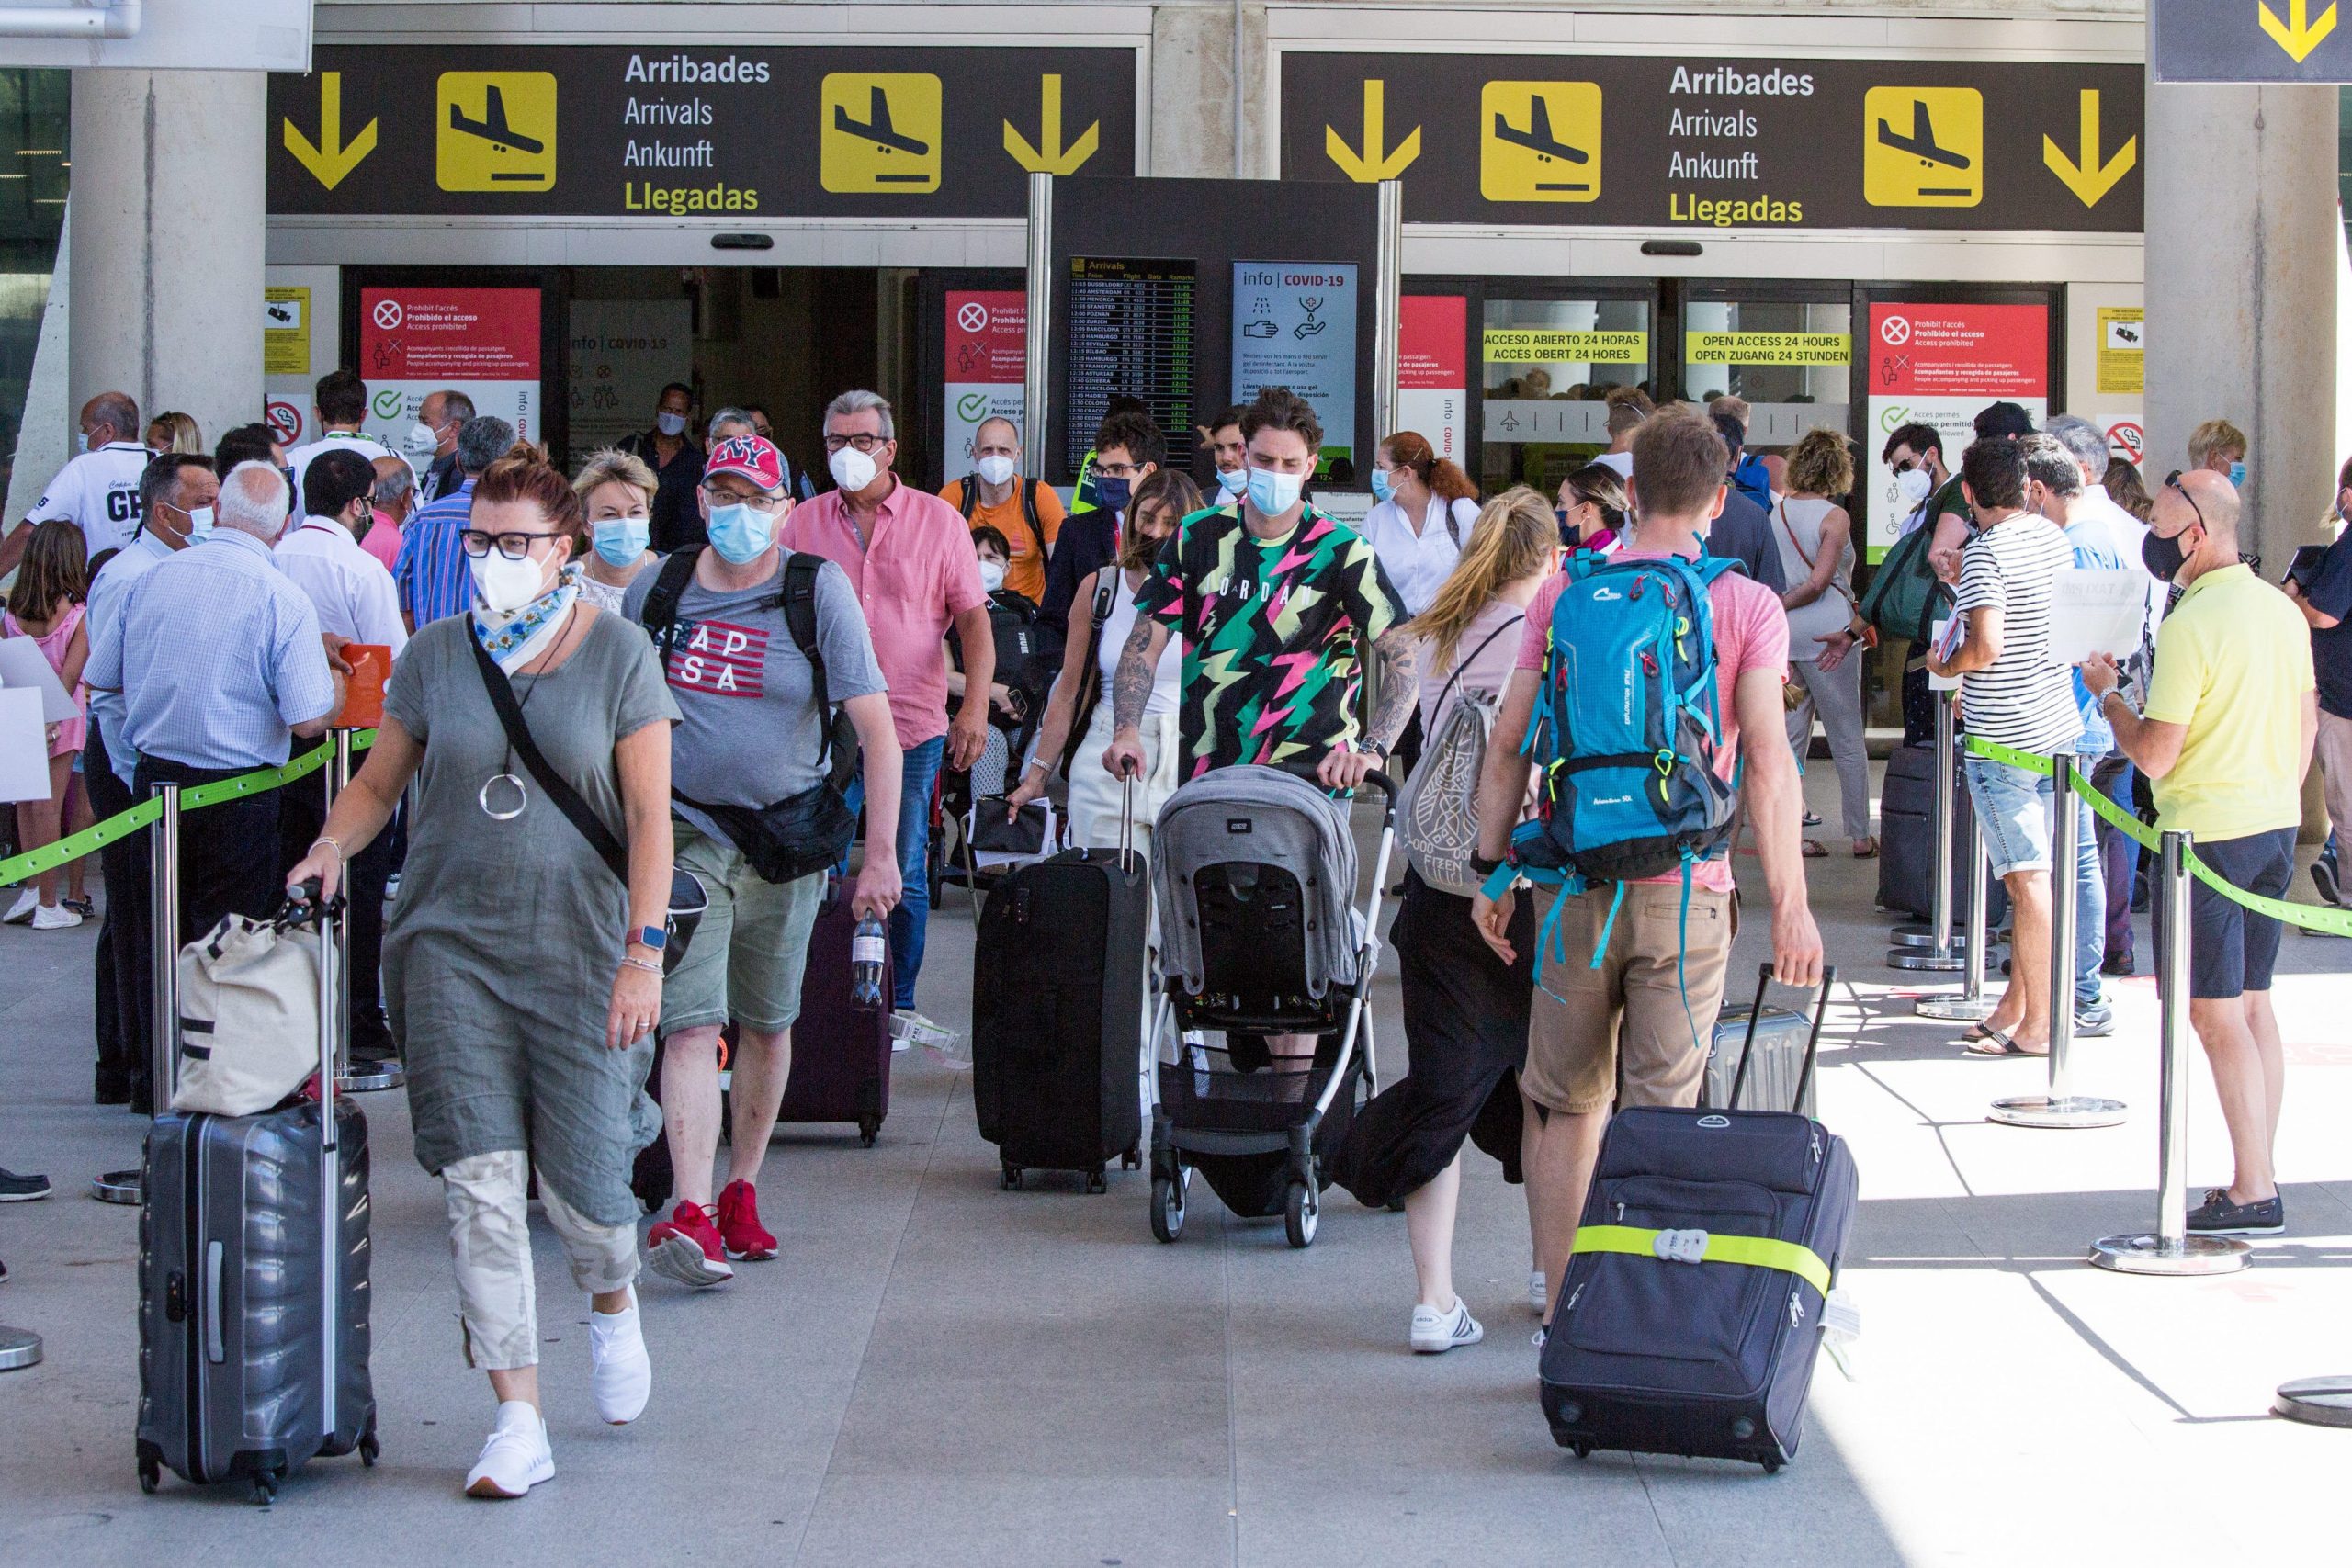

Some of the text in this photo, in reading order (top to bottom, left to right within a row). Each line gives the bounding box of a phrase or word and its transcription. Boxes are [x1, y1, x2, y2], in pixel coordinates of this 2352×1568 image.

[625, 55, 770, 84] Arribades
[1669, 66, 1814, 96] Arribades
[625, 97, 713, 125] Arrivals
[1669, 108, 1758, 137] Arrivals
[624, 140, 713, 167] Ankunft
[1668, 151, 1758, 179] Ankunft
[626, 182, 758, 215] Llegadas
[1670, 194, 1803, 227] Llegadas
[1089, 261, 1125, 270] Arrivals
[1244, 272, 1344, 287] info COVID-19
[407, 304, 434, 312] Prohibit
[1484, 335, 1640, 347] ACCESO ABIERTO 24 HORAS
[1703, 336, 1841, 348] OPEN ACCESS 24 HOURS
[1493, 347, 1631, 360] ACCÉS OBERT 24 HORES
[1695, 350, 1849, 362] OPEN ZUGANG 24 STUNDEN
[518, 391, 528, 411] info
[1444, 400, 1454, 420] info
[717, 435, 770, 469] NY
[110, 480, 131, 490] Coppa
[1203, 572, 1312, 606] JORDAN
[1018, 632, 1029, 654] THULE
